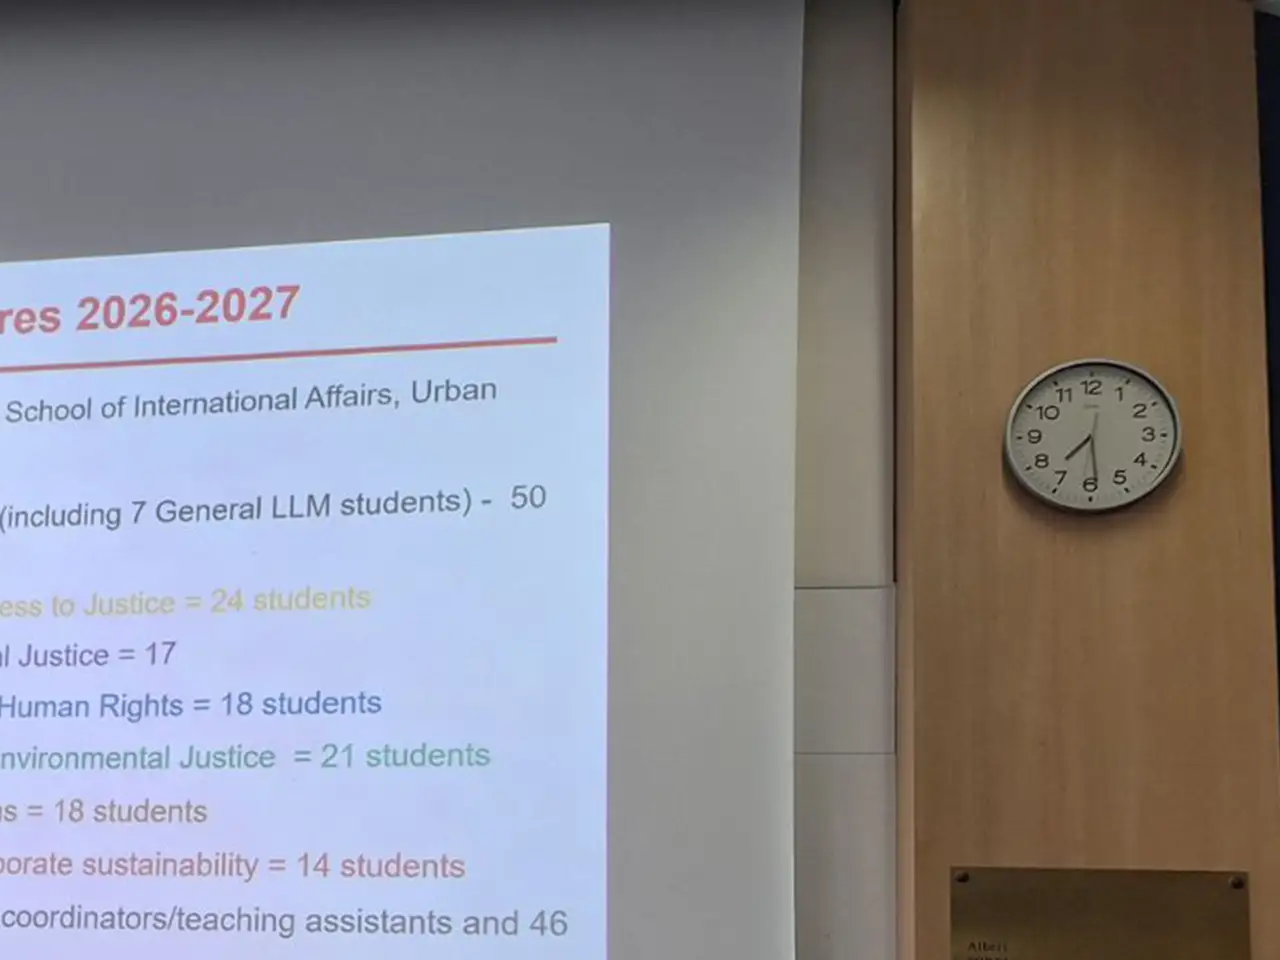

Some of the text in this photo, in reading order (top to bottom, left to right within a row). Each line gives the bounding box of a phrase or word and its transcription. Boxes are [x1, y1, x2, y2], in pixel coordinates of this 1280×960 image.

[75, 284, 301, 331] 2026-2027
[1056, 388, 1071, 402] 11
[1080, 380, 1102, 395] 12
[1115, 387, 1123, 401] 1
[4, 396, 92, 424] School
[100, 395, 127, 420] of
[134, 386, 298, 418] International
[304, 383, 400, 410] Affairs,
[412, 378, 497, 404] Urban
[1036, 406, 1060, 420] 10
[1133, 403, 1147, 418] 2
[1027, 429, 1042, 443] 9
[1142, 427, 1155, 441] 3
[1035, 454, 1049, 468] 8
[1133, 453, 1147, 466] 4
[1055, 470, 1067, 485] 7
[1083, 477, 1098, 492] 6
[1113, 470, 1126, 484] 5
[131, 500, 147, 525] 7
[155, 495, 262, 524] General
[272, 492, 331, 520] LLM
[340, 487, 472, 517] students)
[511, 484, 547, 510] 50
[51, 594, 77, 618] to
[82, 591, 177, 618] Justice
[211, 587, 246, 615] 24
[253, 585, 374, 612] students
[18, 643, 110, 668] Justice
[145, 640, 177, 666] 17
[99, 692, 184, 724] Rights
[221, 691, 254, 716] 18
[262, 690, 383, 716] students
[179, 743, 277, 770] Justice
[320, 742, 353, 769] 21
[365, 742, 492, 768] students
[54, 797, 85, 824] 18
[93, 798, 209, 824] students
[82, 851, 260, 884] sustainability
[297, 851, 332, 878] 14
[340, 851, 466, 879] students
[1, 904, 295, 940] coordinators/teaching
[305, 907, 453, 936] assistants
[462, 909, 519, 936] and
[529, 909, 569, 937] 46
